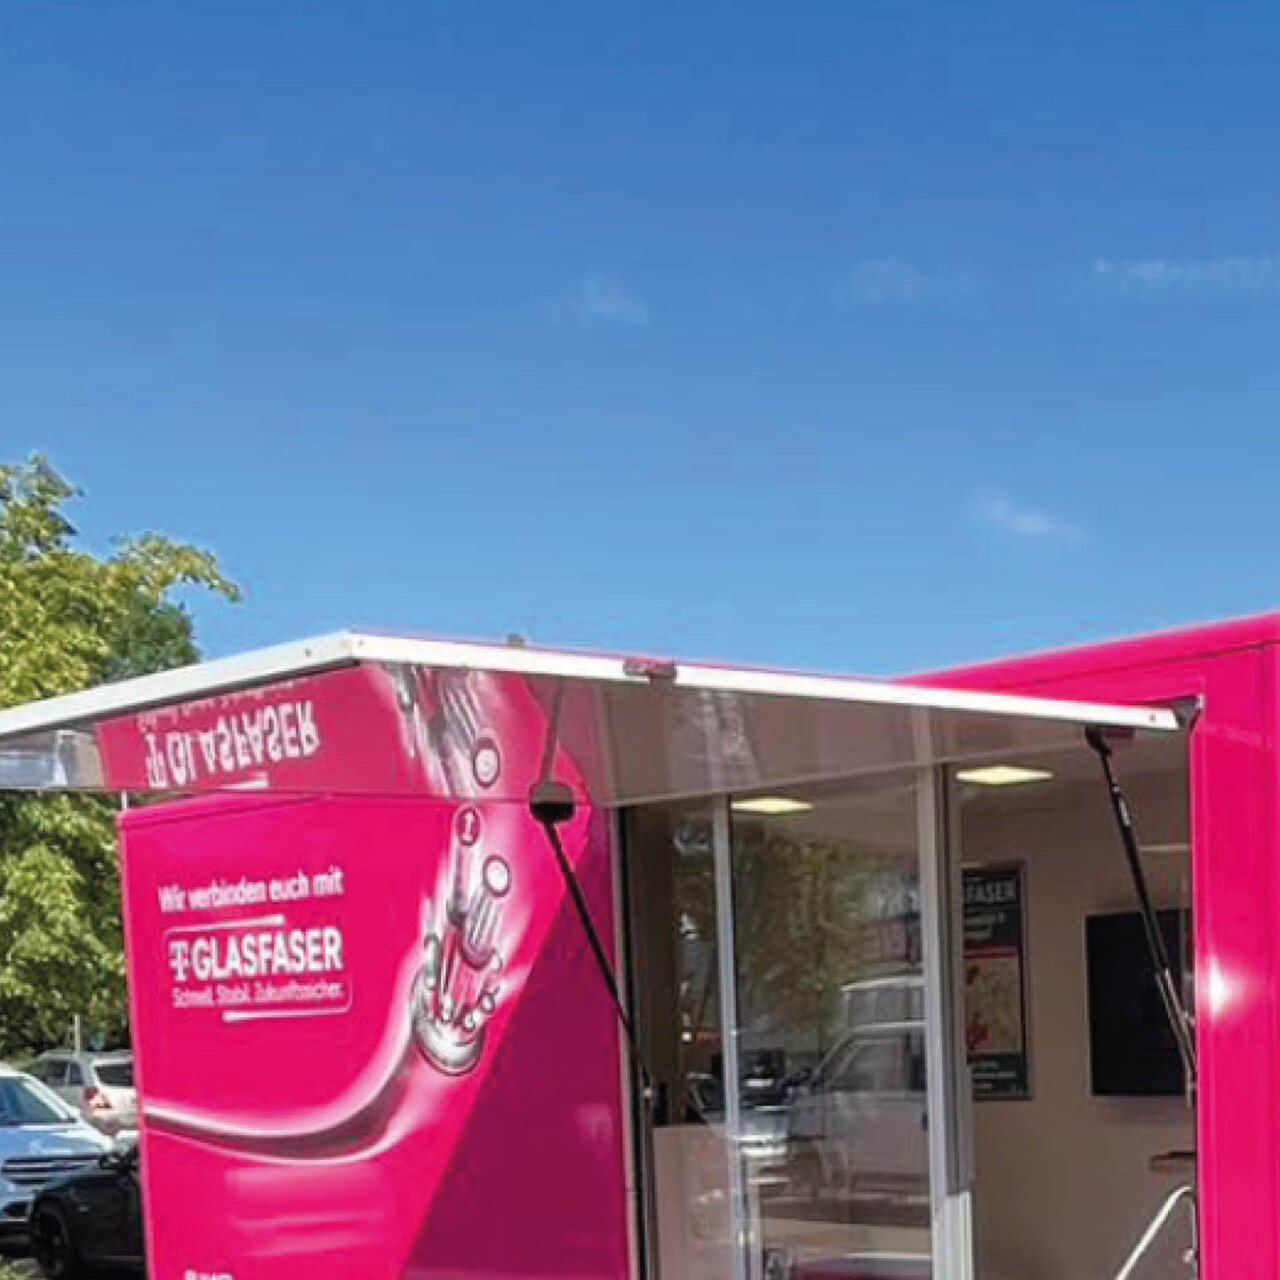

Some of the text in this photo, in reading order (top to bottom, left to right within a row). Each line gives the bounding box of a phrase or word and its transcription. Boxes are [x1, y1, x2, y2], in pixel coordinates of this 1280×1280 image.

[269, 867, 309, 901] euch
[312, 864, 345, 896] mit
[191, 925, 344, 981] GLASFASER
